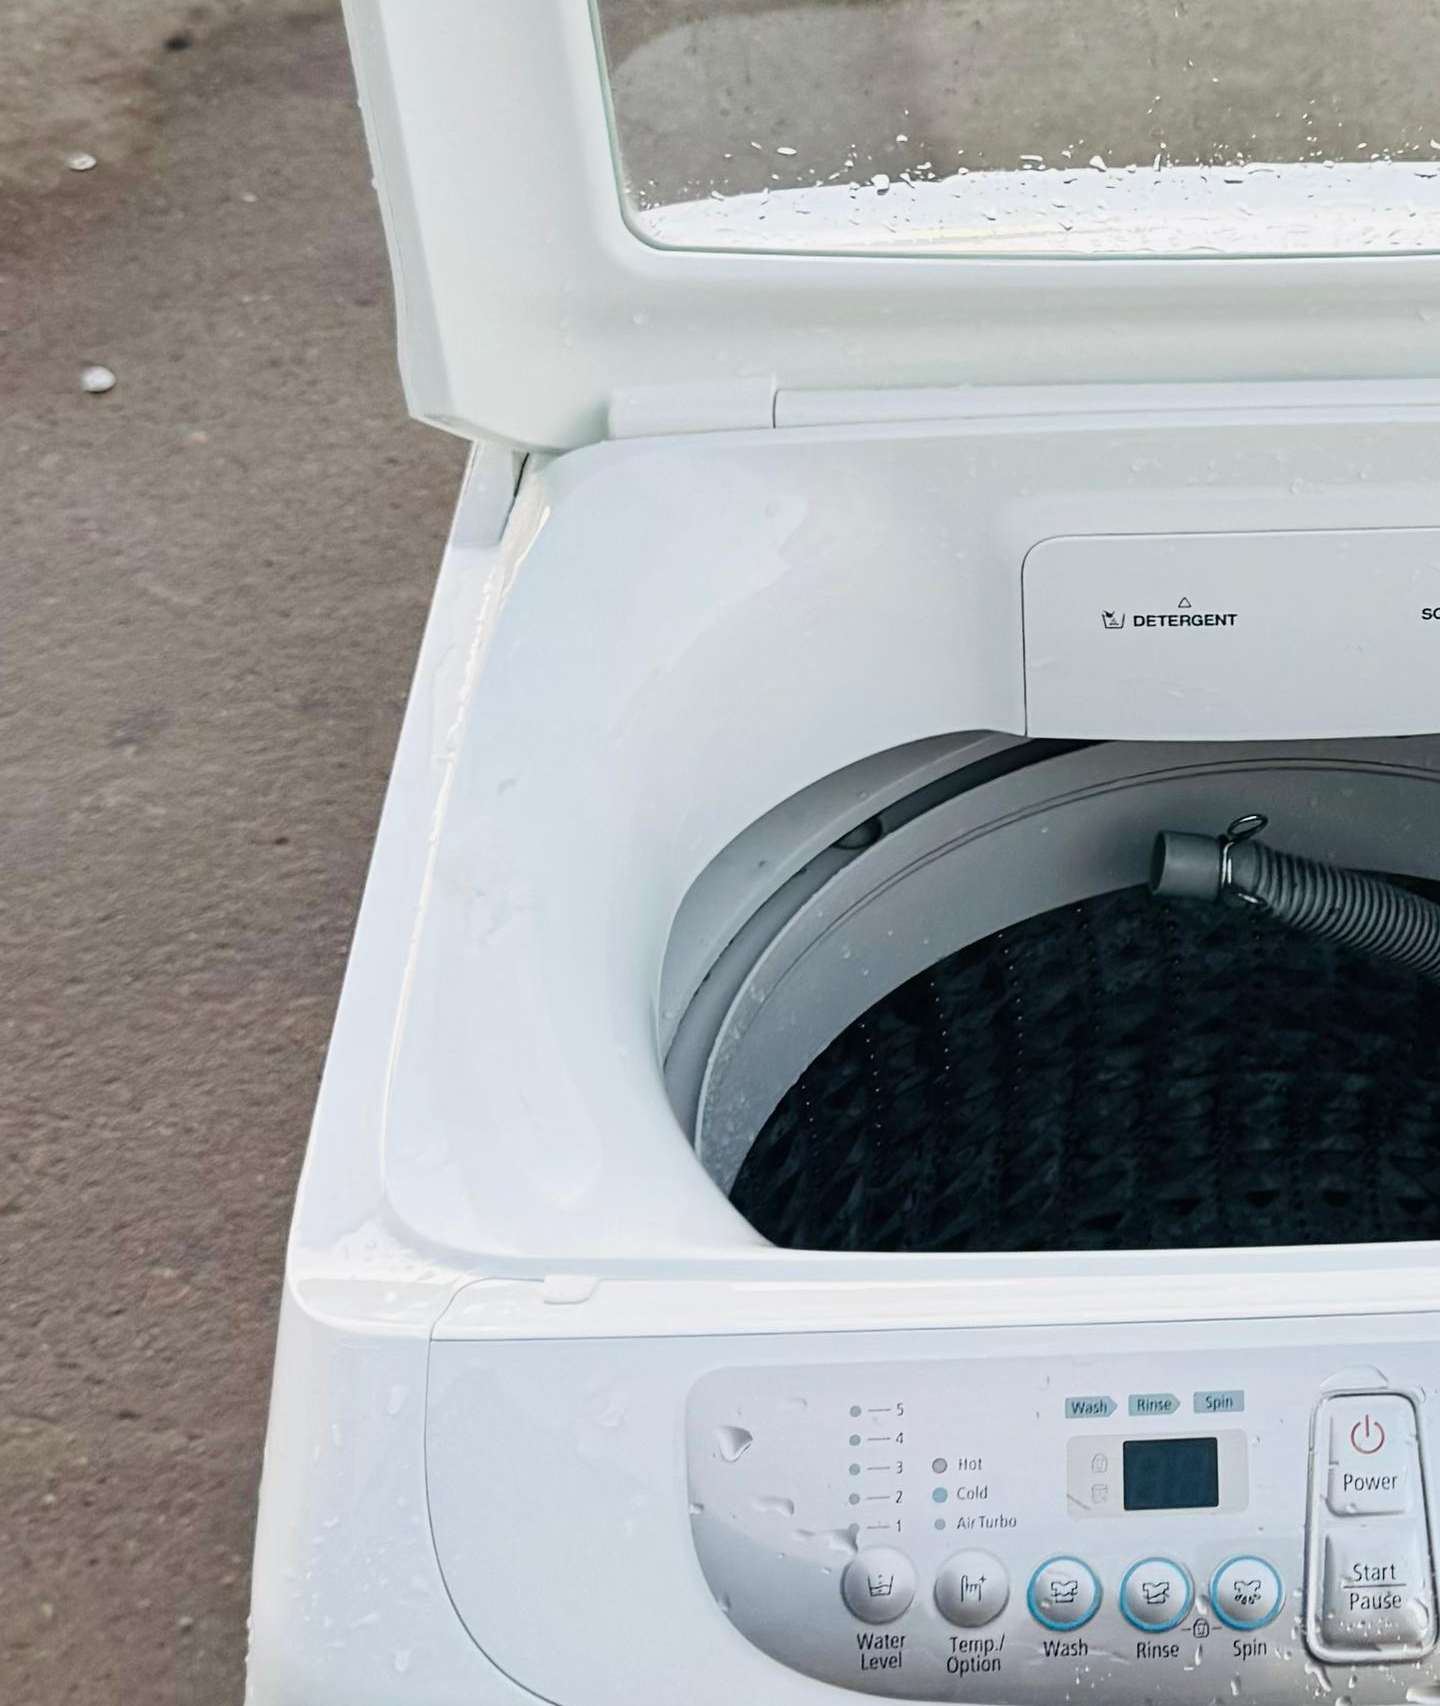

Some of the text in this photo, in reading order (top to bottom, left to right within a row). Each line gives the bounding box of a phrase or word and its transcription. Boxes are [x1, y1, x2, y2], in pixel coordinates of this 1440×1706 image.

[1132, 613, 1238, 628] DETERGENT
[896, 1402, 904, 1416] 5
[1071, 1400, 1107, 1415] Wash
[1137, 1398, 1173, 1412] Rinse
[1205, 1395, 1233, 1411] Spin
[895, 1432, 904, 1444] 4
[896, 1461, 904, 1474] 3
[958, 1458, 983, 1471] Hot
[1343, 1473, 1399, 1492] Power
[895, 1490, 904, 1504] 2
[956, 1486, 988, 1500] Cold
[956, 1514, 1017, 1530] Air Turbo
[1353, 1563, 1397, 1581] Start
[1350, 1593, 1402, 1610] Pause
[857, 1633, 907, 1650] Water
[950, 1634, 1006, 1656] Temp./
[1043, 1640, 1089, 1658] Wash
[1136, 1641, 1180, 1659] Rinse
[1233, 1639, 1268, 1661] Spin
[861, 1652, 902, 1670] Level
[946, 1656, 1002, 1678] Option
